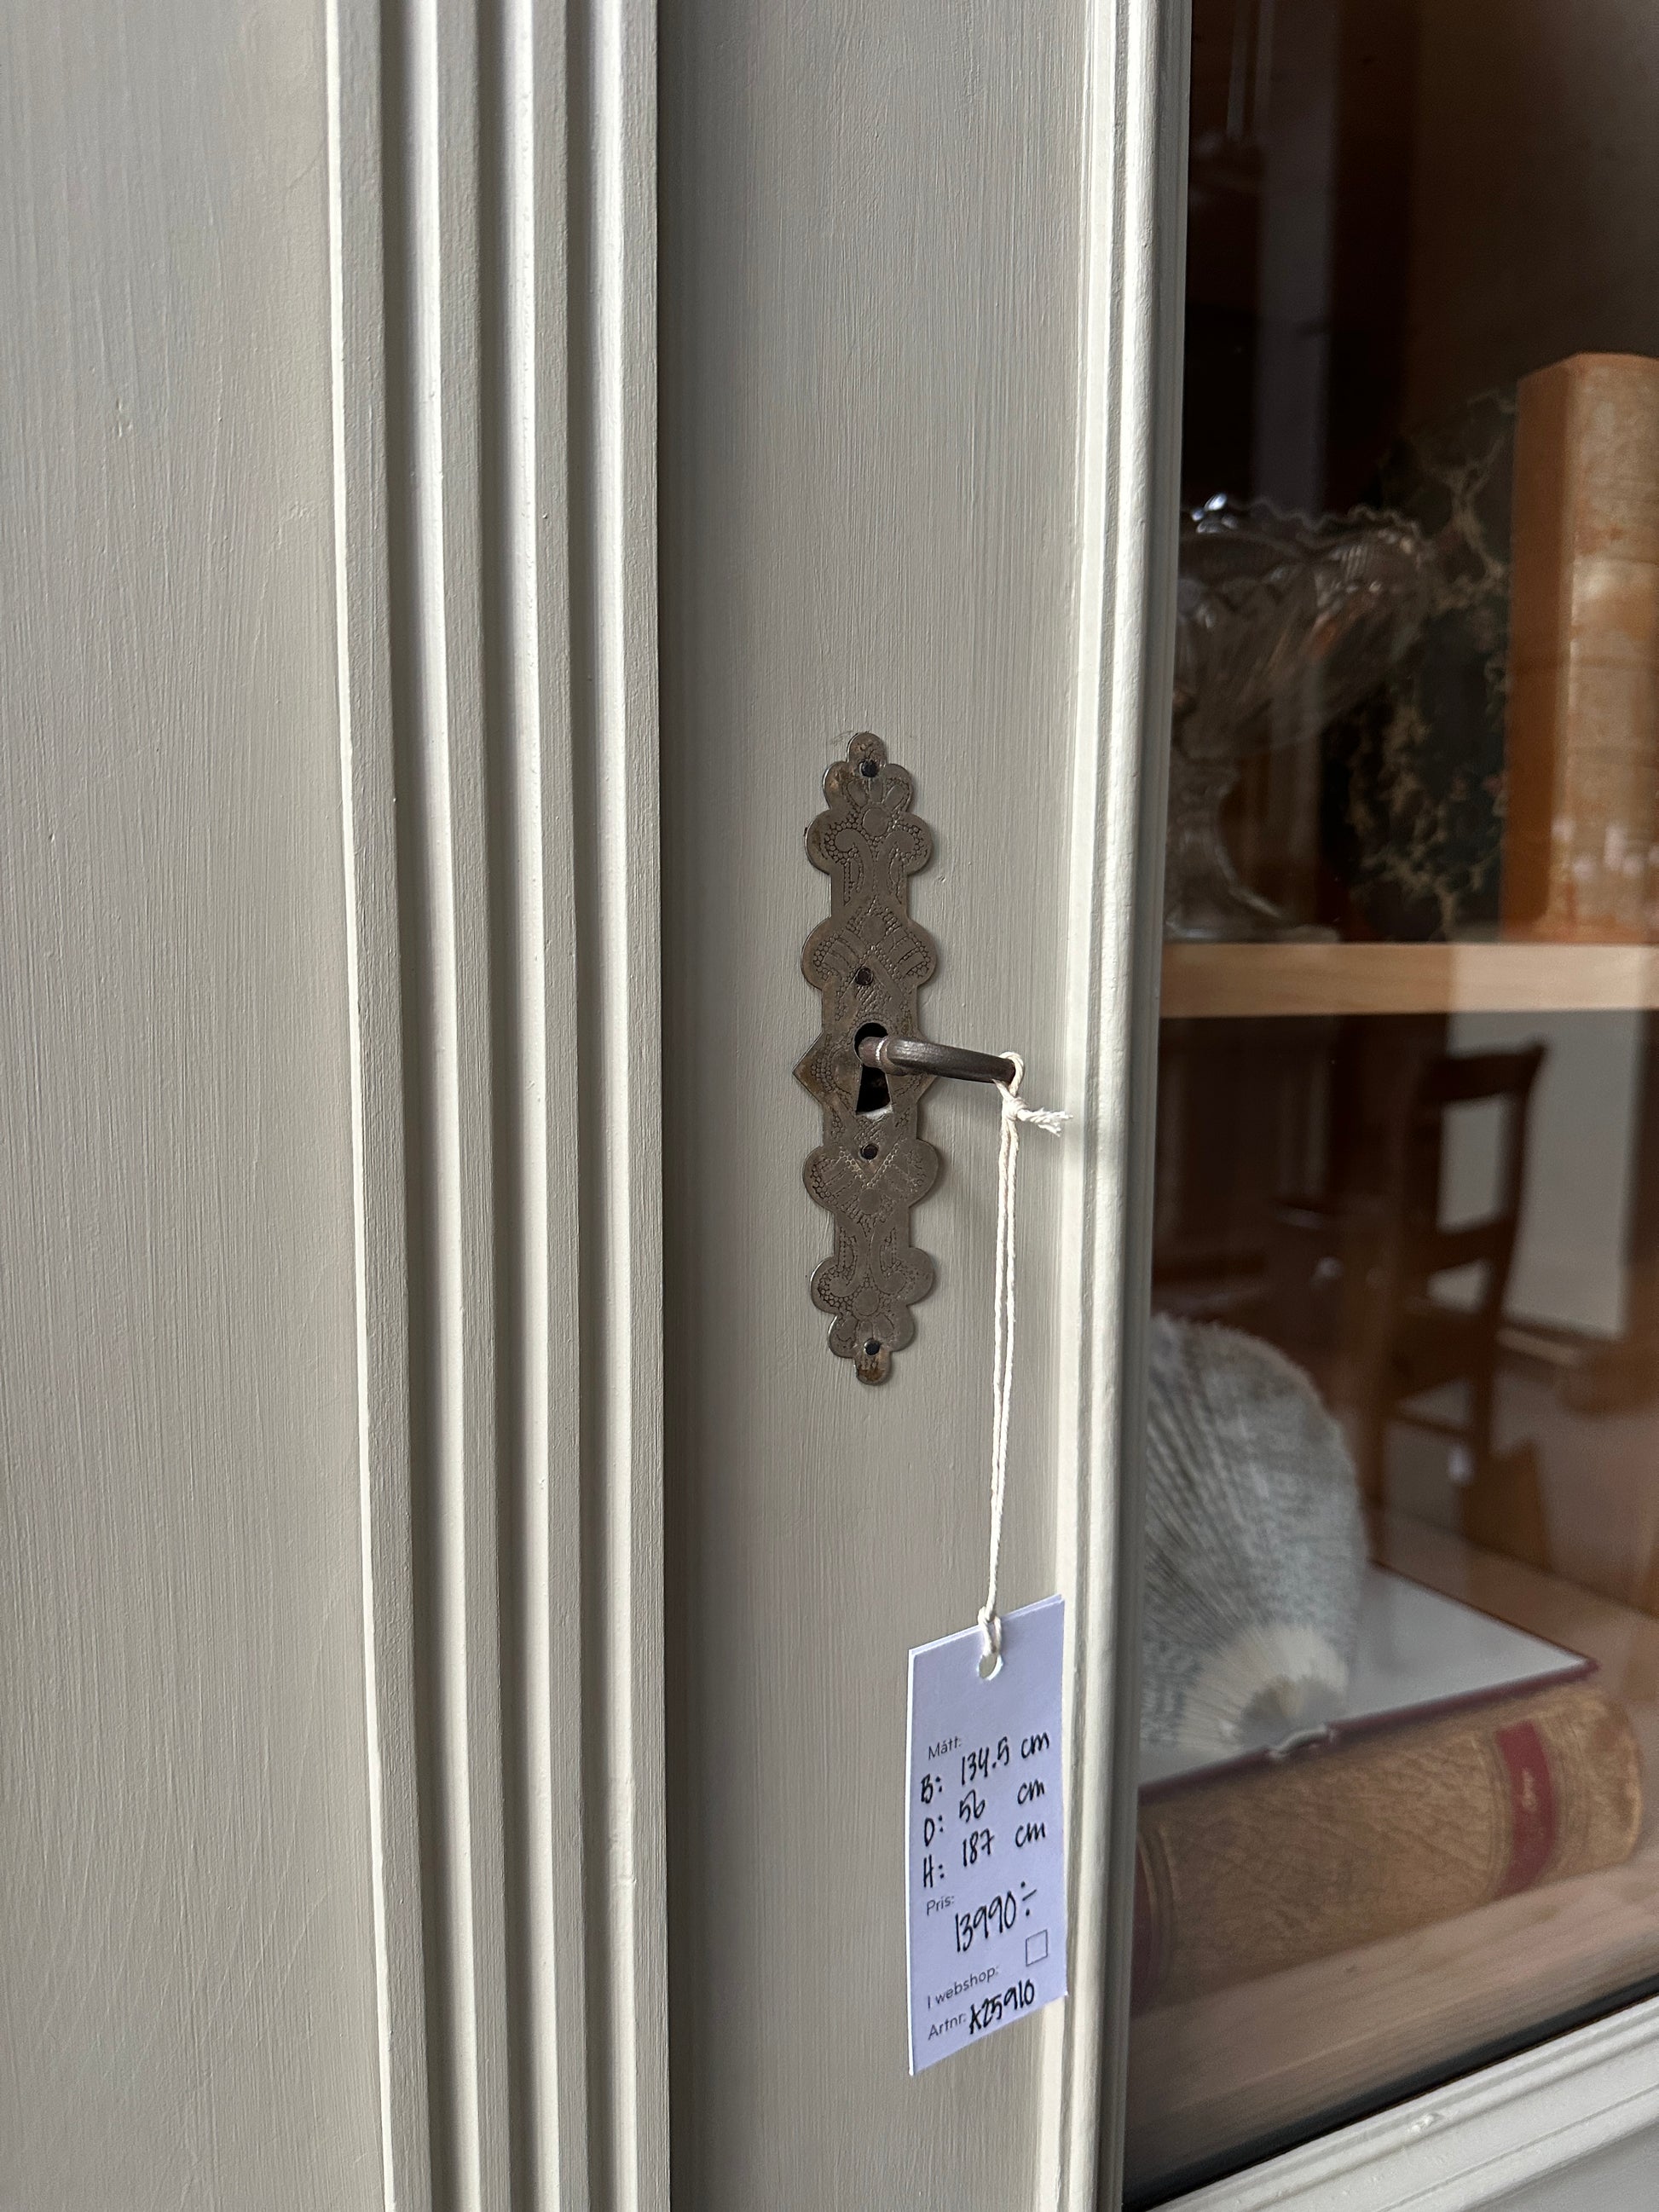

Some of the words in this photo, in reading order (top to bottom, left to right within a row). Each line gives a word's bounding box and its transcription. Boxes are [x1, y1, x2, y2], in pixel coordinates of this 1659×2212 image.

[921, 1773, 943, 1804] B:
[1020, 1731, 1050, 1759] cm
[959, 1789, 986, 1822] 56
[1017, 1778, 1045, 1805] cm
[923, 1854, 945, 1888] H:
[962, 1828, 995, 1867] 187
[1014, 1822, 1046, 1848] cm
[926, 1895, 955, 1916] Pris:
[935, 1965, 1000, 2005] webshop:
[928, 2013, 967, 2041] Artnr:
